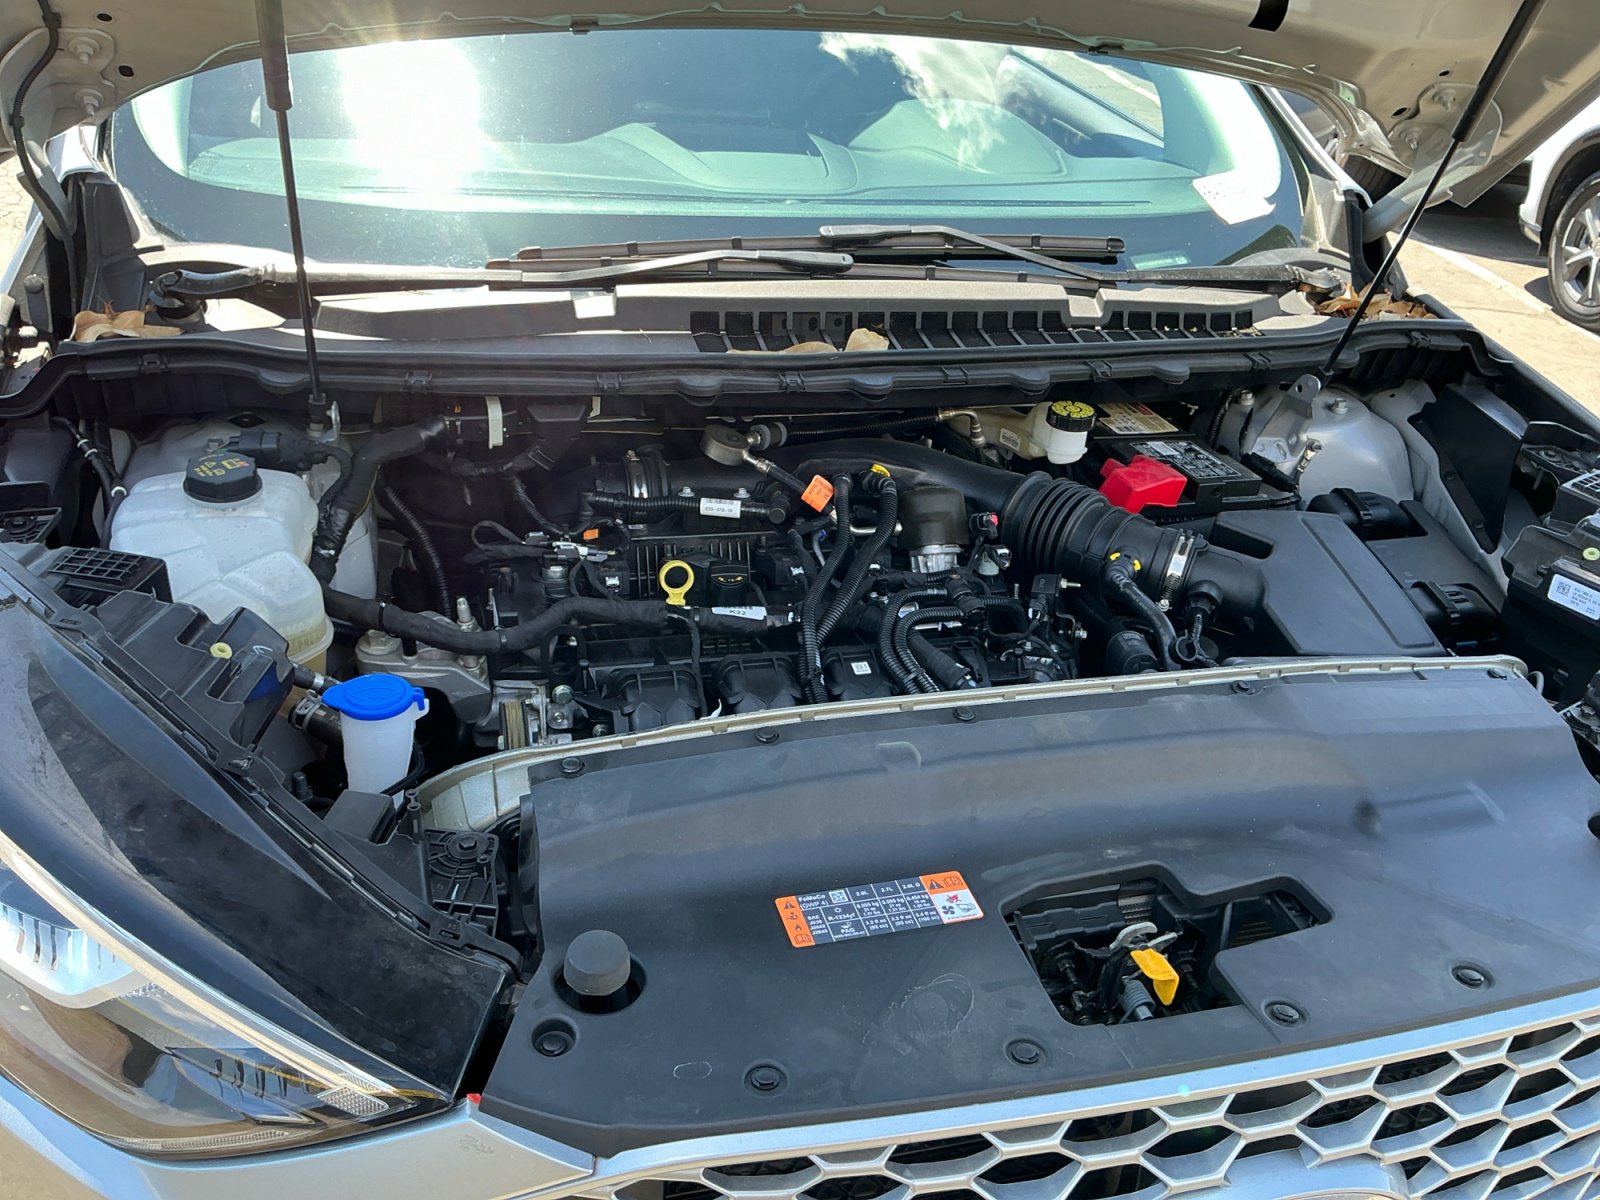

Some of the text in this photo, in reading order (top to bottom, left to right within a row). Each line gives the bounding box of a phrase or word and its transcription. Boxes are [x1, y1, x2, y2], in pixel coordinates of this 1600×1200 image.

[798, 894, 826, 902] FoMoCo
[800, 901, 821, 910] (GWP
[827, 913, 856, 922] R-1234yf
